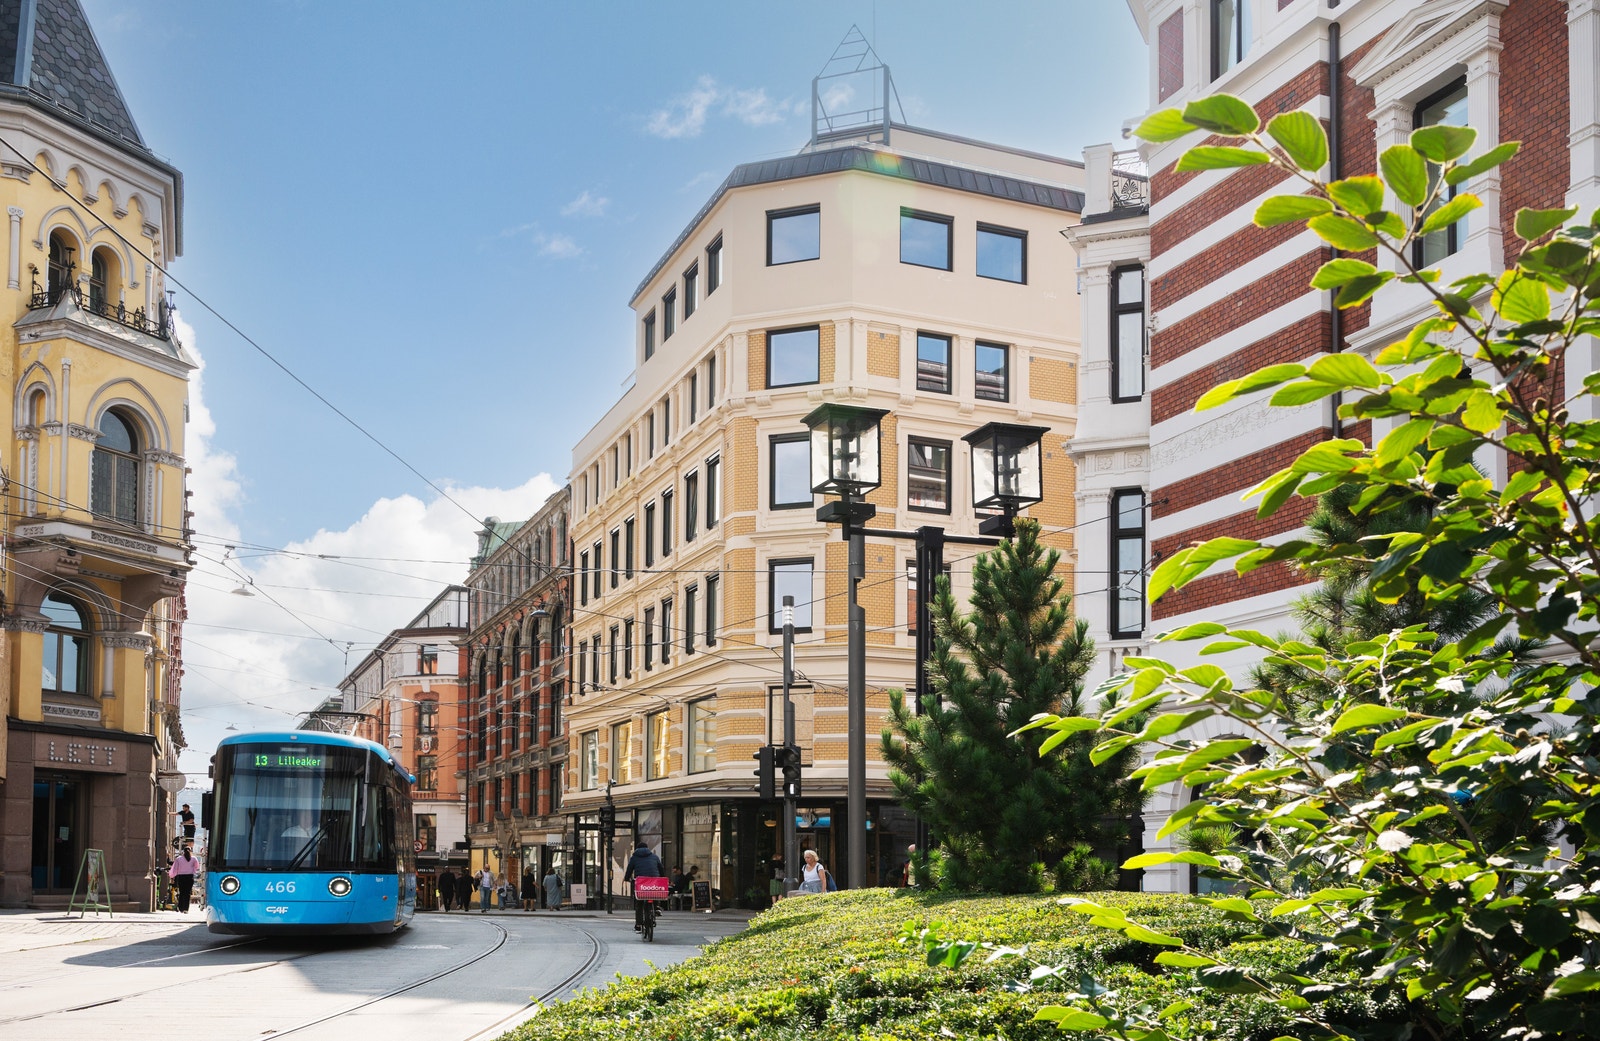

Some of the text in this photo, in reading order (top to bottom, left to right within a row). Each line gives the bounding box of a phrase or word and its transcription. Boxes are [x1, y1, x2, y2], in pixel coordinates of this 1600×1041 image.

[49, 741, 116, 765] LETT
[255, 755, 321, 766] 13 Lilleaker
[265, 881, 296, 893] 466
